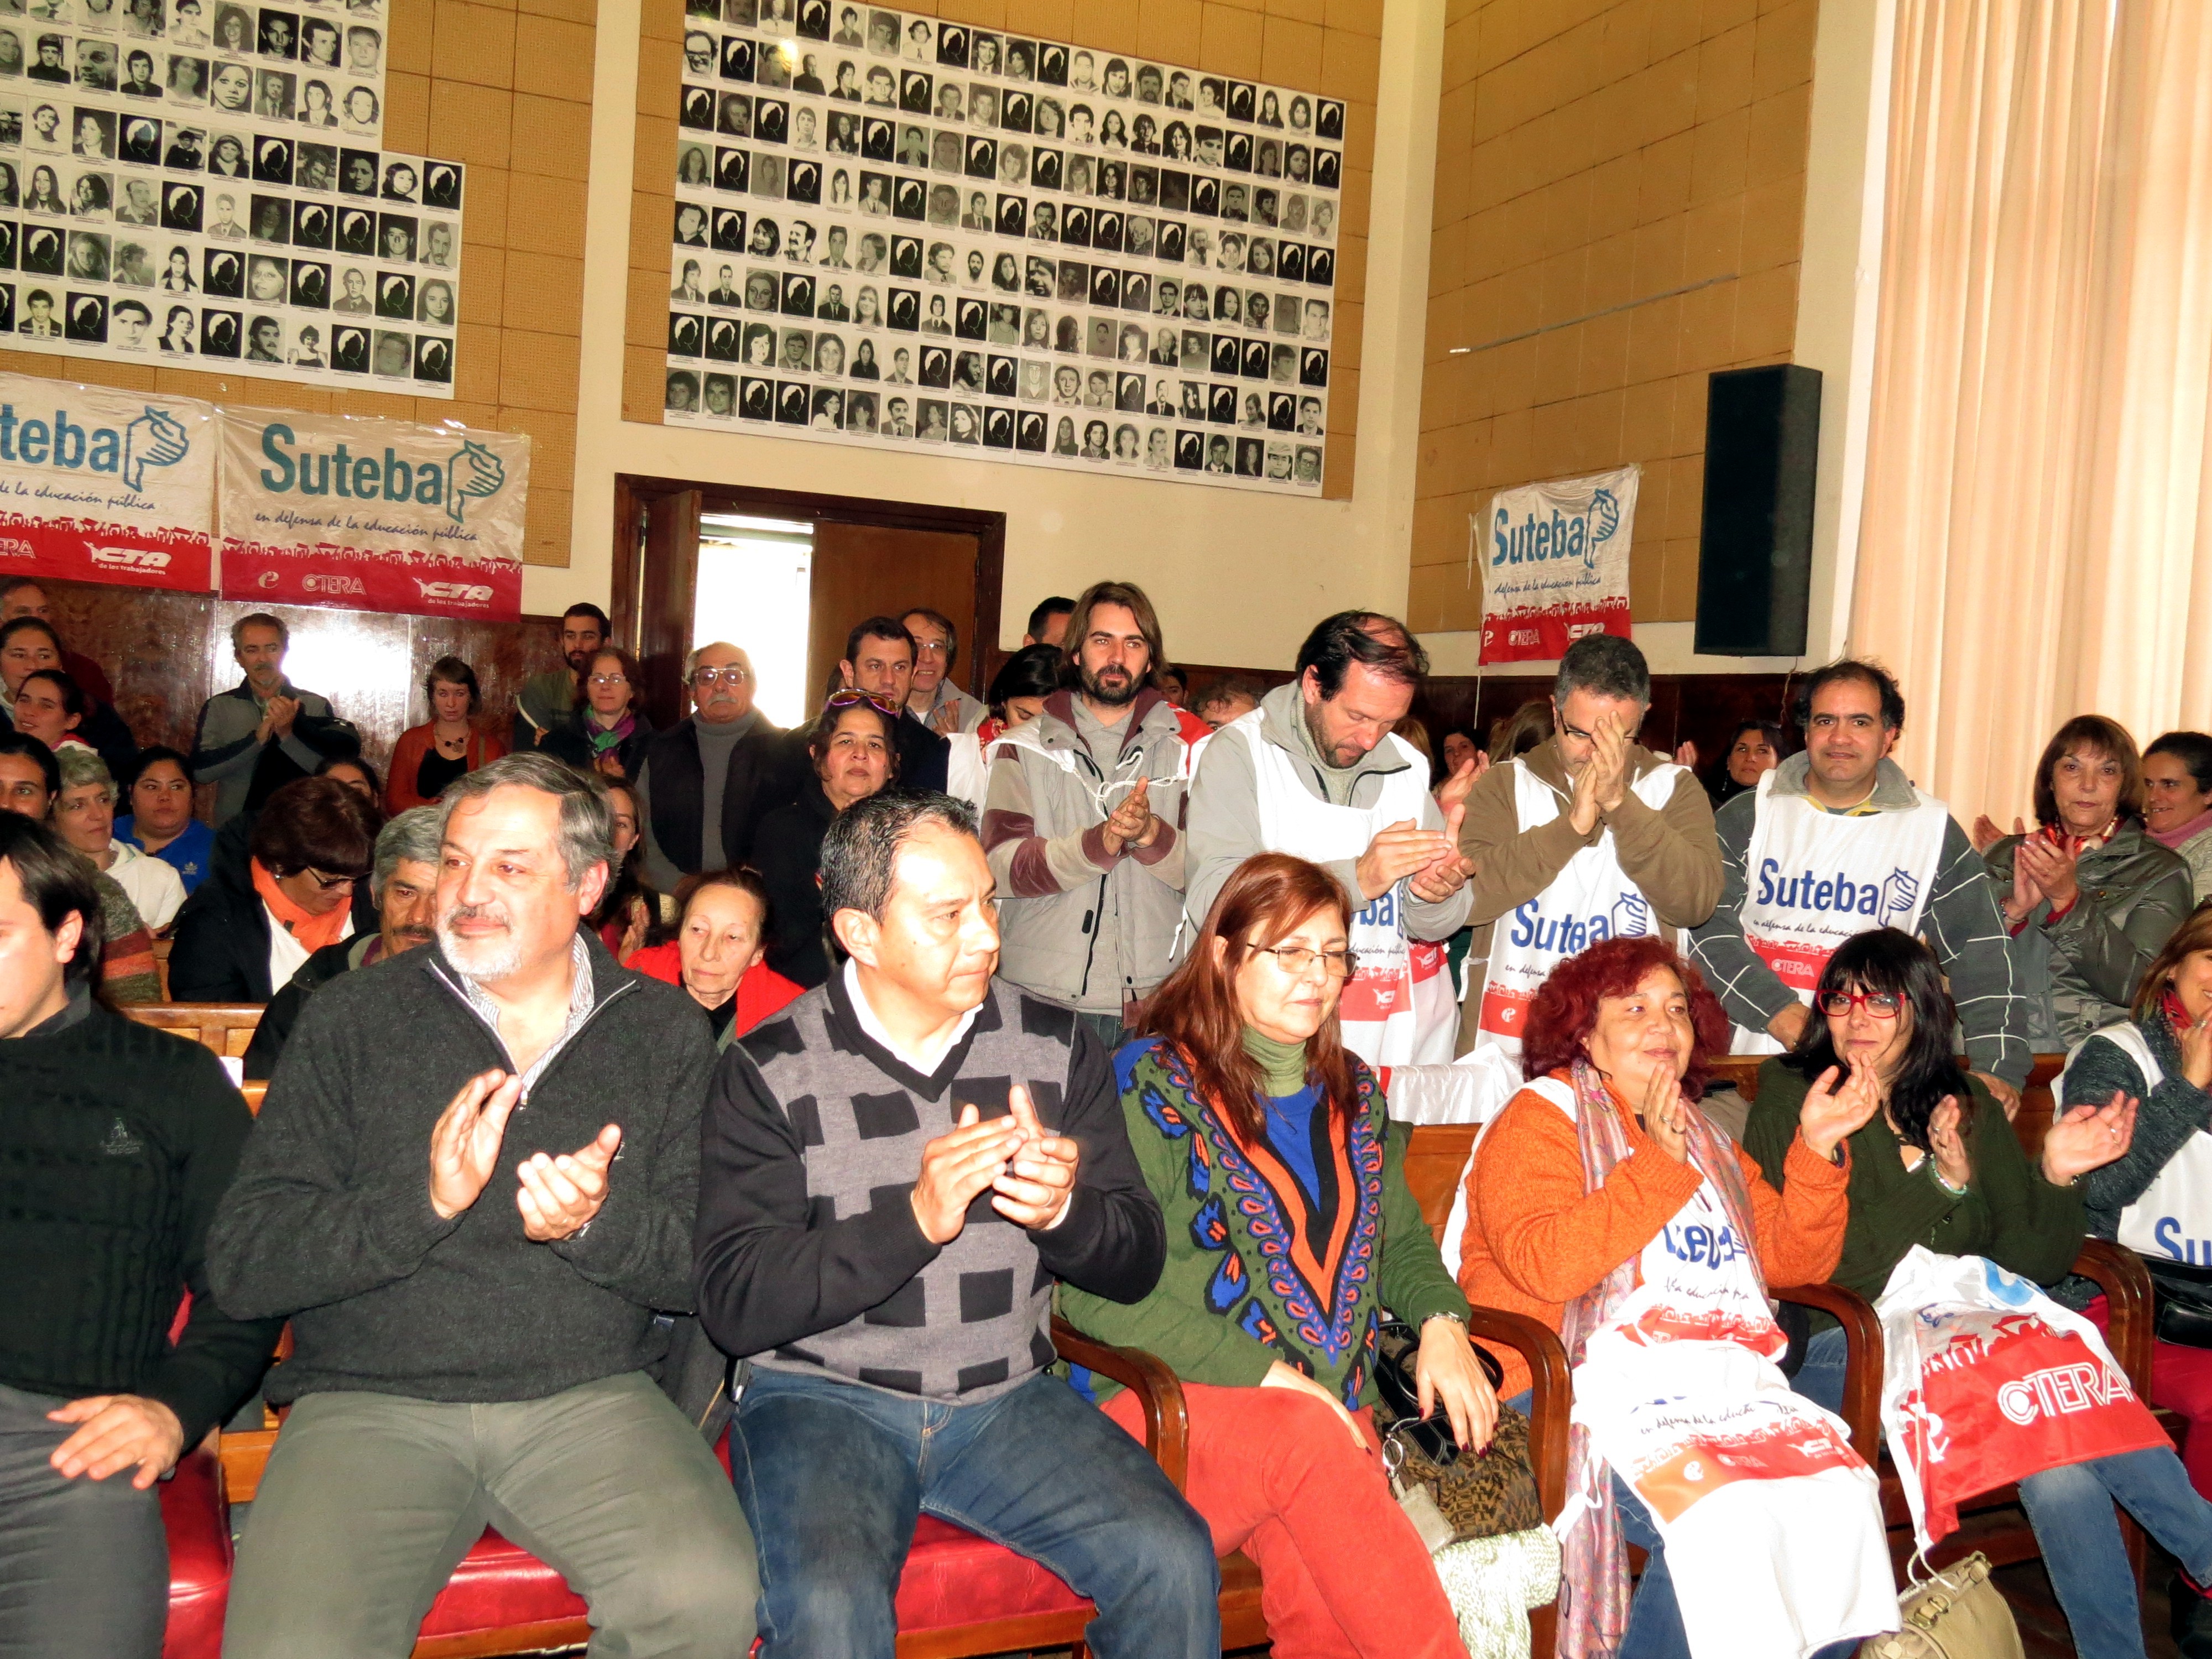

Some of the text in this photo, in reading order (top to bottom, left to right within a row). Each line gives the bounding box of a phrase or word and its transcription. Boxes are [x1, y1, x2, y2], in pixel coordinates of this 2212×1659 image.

[260, 423, 442, 505] Suteba
[15, 481, 29, 495] la
[34, 485, 102, 503] educación
[107, 493, 156, 510] pública
[255, 510, 478, 542] en defensa de la educación pública
[1492, 508, 1585, 566] Suteba
[98, 546, 172, 567] CTA
[121, 565, 166, 575] trabajadores
[302, 573, 368, 596] CTERA
[427, 581, 494, 601] CTA
[447, 599, 489, 609] trabajadores
[1508, 628, 1541, 646] CTERA
[1756, 858, 1880, 916] Suteba
[1510, 898, 1609, 954] Sutea
[1761, 919, 1791, 932] defensa
[1793, 922, 1804, 932] de
[1806, 922, 1817, 933] la
[1819, 925, 1854, 937] educaci
[1349, 942, 1386, 954] ducación
[1519, 963, 1546, 979] defensa
[1771, 958, 1815, 978] CTERA
[1997, 1361, 2136, 1426] CTERA
